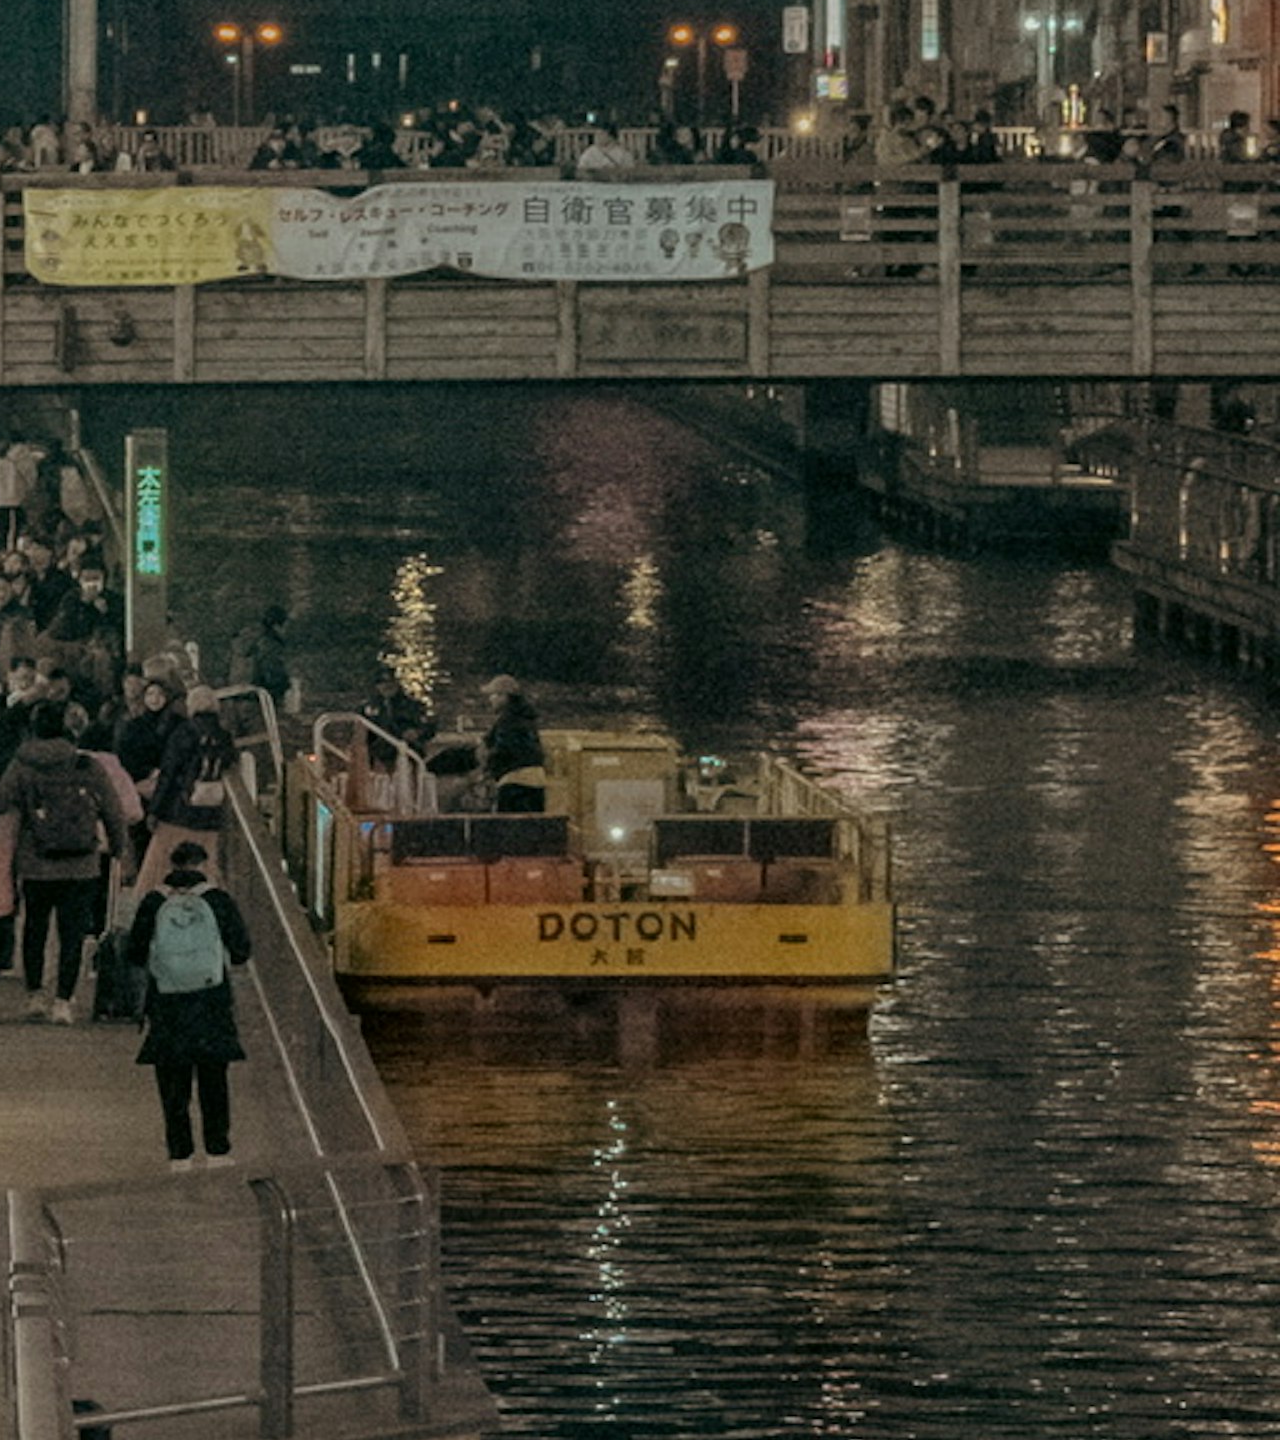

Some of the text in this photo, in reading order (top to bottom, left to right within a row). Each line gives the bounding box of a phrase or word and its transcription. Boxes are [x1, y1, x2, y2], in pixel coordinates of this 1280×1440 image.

[523, 194, 759, 225] 自衛官募集中
[537, 911, 698, 943] DOTON
